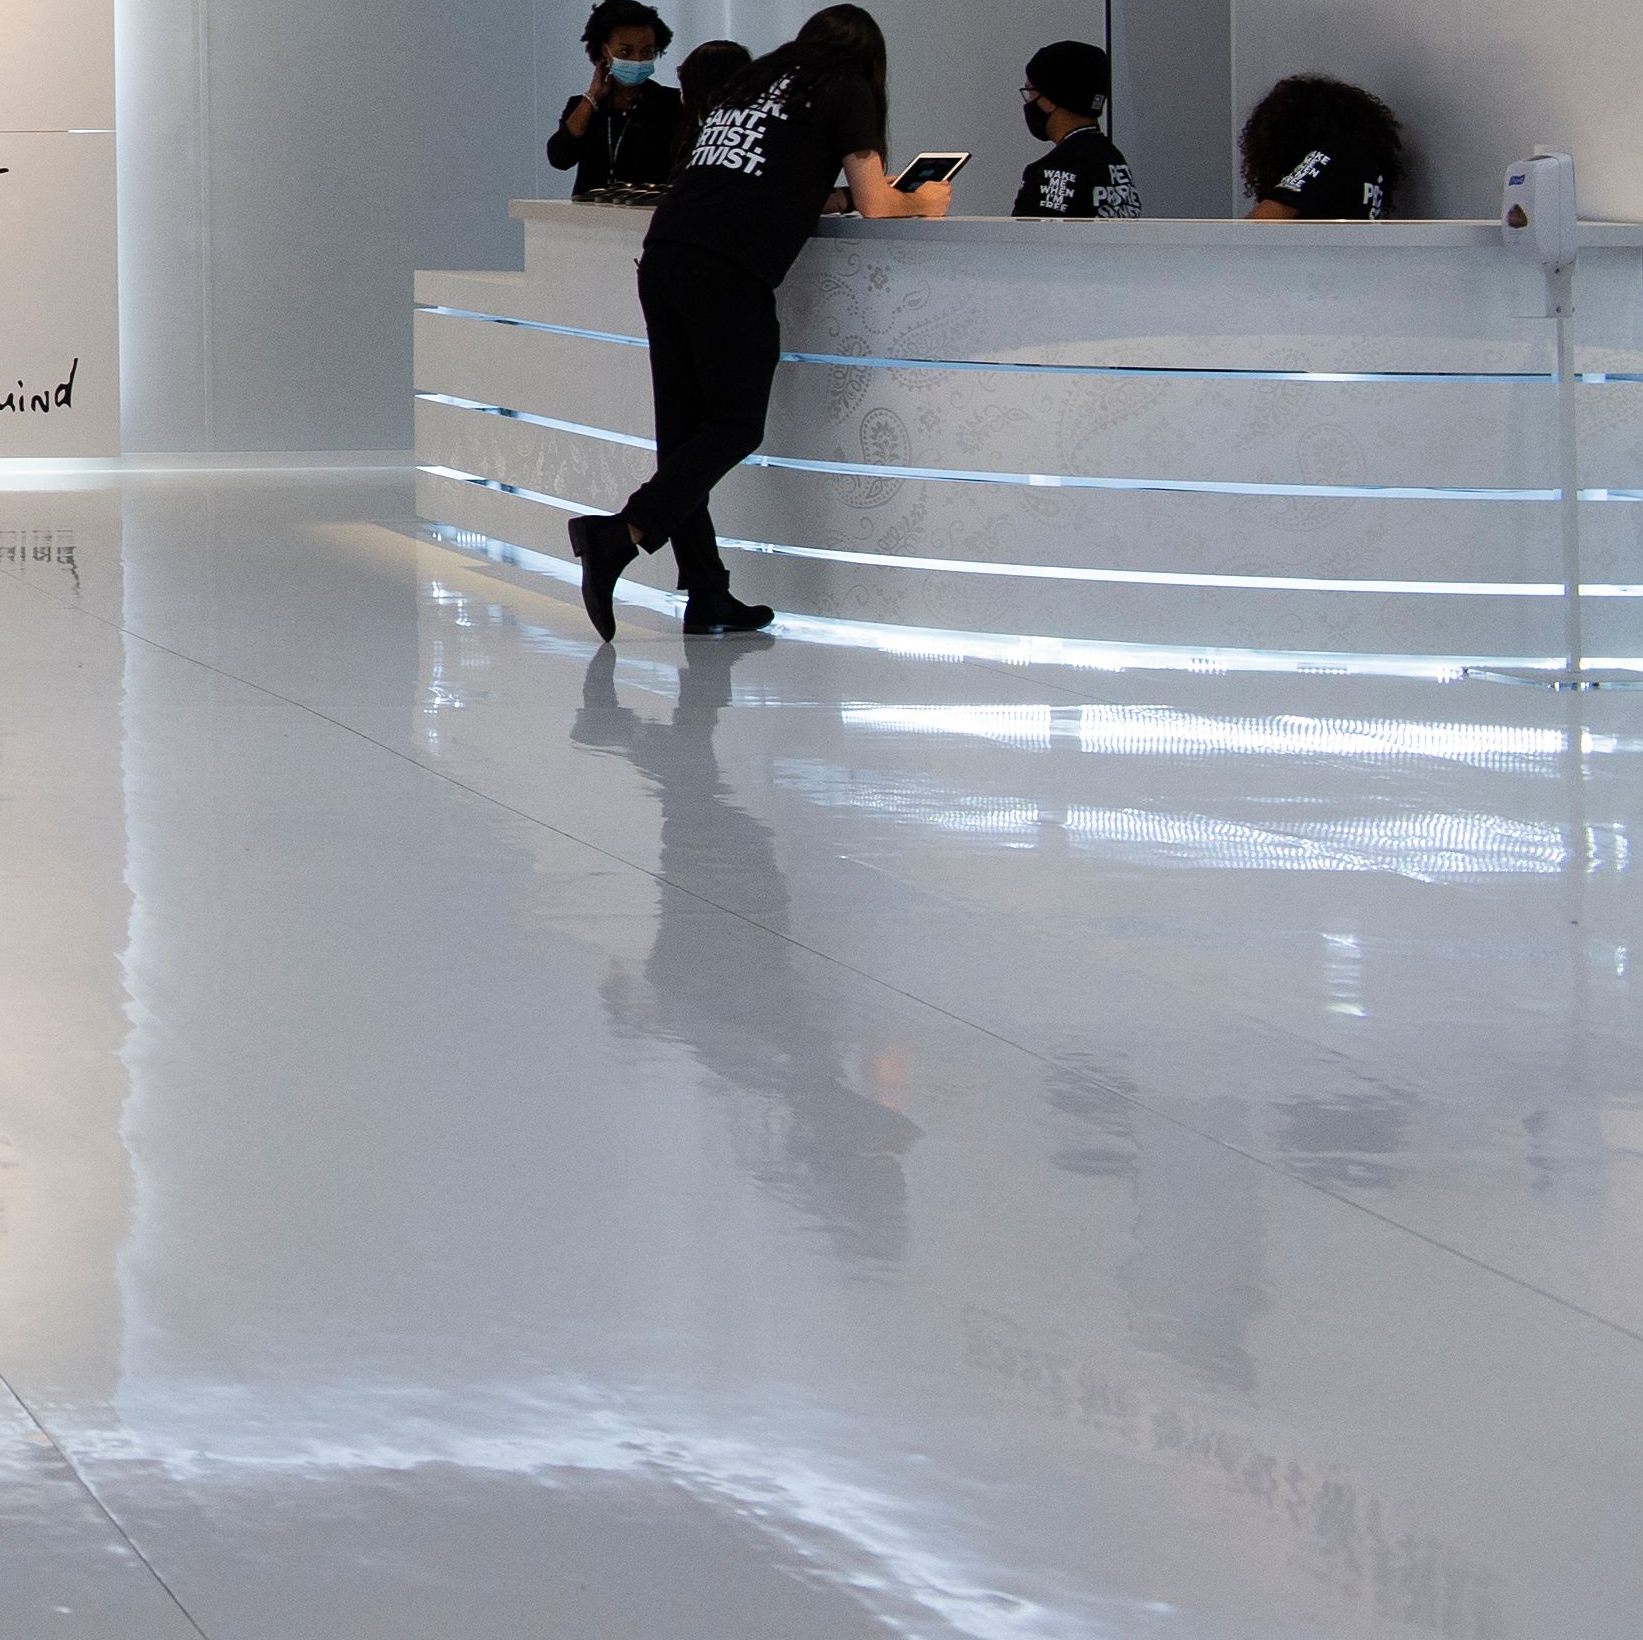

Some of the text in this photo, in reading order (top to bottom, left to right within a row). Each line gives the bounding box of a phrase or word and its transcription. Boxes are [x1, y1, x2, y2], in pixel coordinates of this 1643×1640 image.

[1043, 169, 1077, 183] WAKE
[1049, 178, 1068, 189] ME
[1040, 184, 1075, 198] WHEN
[1039, 200, 1069, 213] FREE
